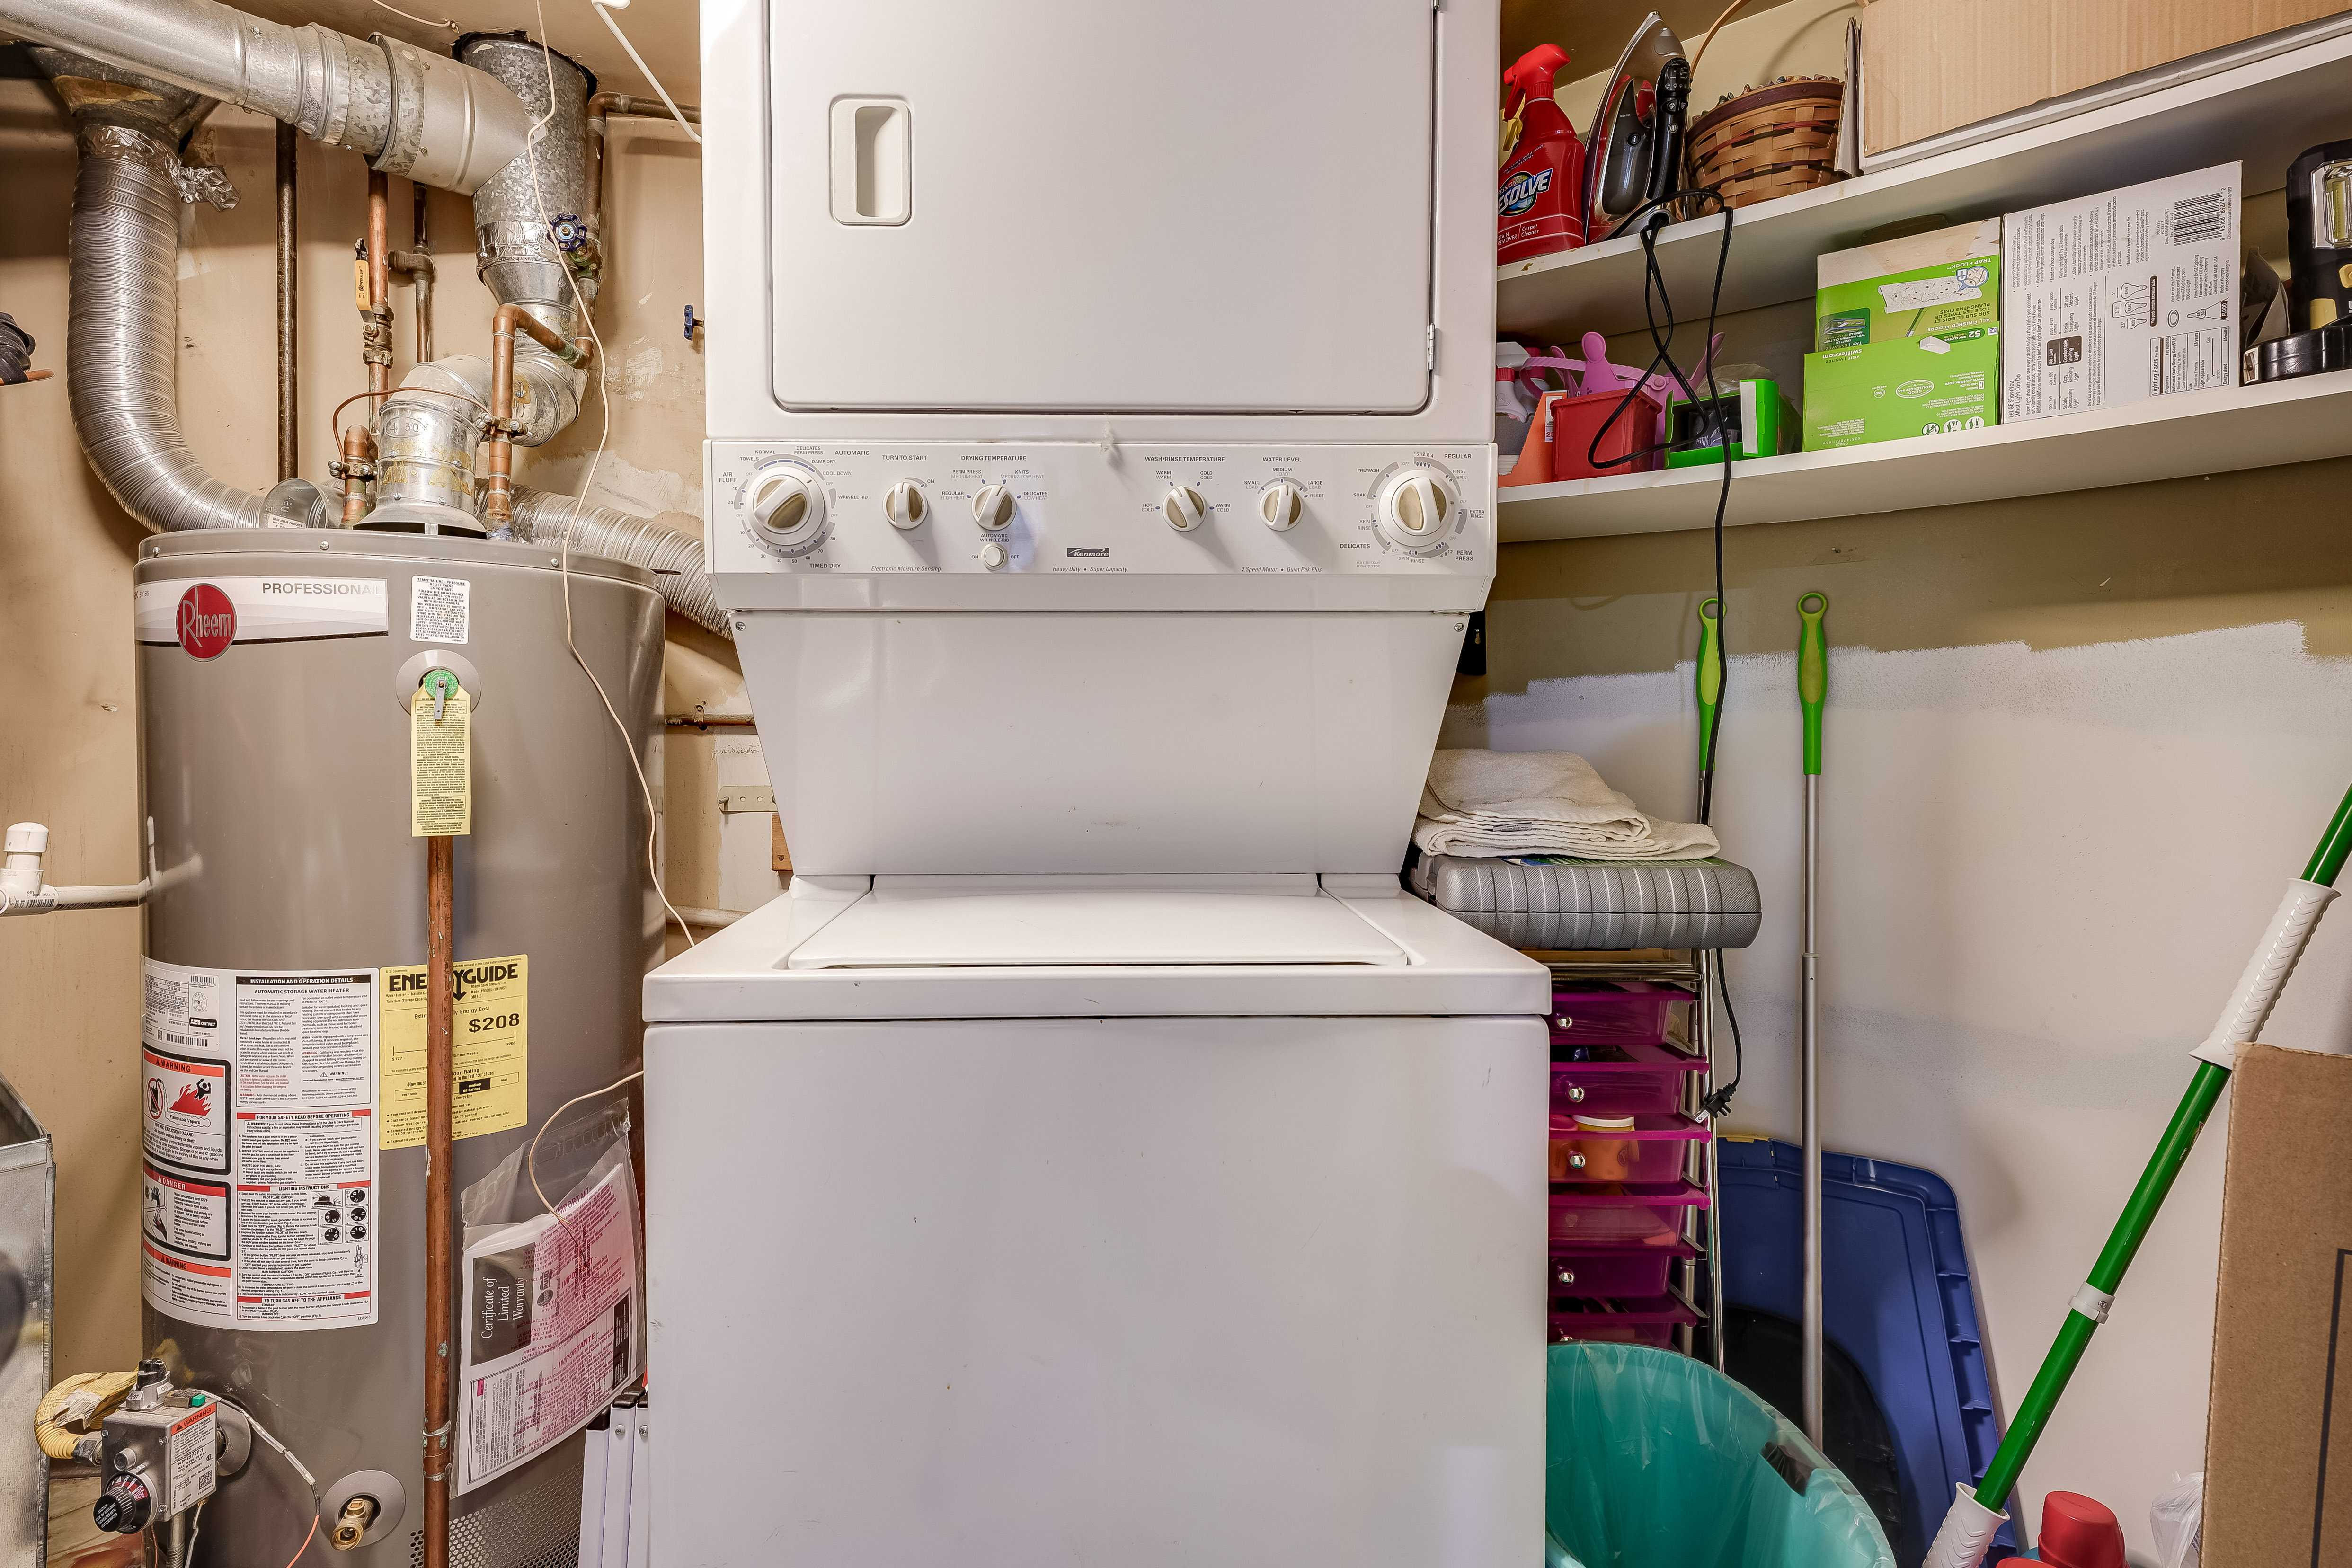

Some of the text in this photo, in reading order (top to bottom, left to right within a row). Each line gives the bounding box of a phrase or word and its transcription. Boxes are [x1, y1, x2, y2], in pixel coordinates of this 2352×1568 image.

[1499, 171, 1550, 213] ESOLVE
[1498, 232, 1509, 240] STAIN
[1498, 235, 1517, 245] REMOVER
[1951, 319, 1978, 328] FINISHED
[1968, 330, 1981, 338] 52
[1822, 348, 1862, 360] swiffer.com
[262, 583, 382, 597] PROFESSIONAL
[183, 587, 231, 647] Rheem
[469, 1013, 520, 1033] $208
[161, 1060, 191, 1072] WARNING
[163, 1178, 186, 1190] DANGER
[166, 1258, 187, 1269] WARNING
[498, 1286, 510, 1321] Limited
[513, 1277, 527, 1320] Warranty
[481, 1277, 497, 1339] Certificate of
[558, 1335, 595, 1369] IMPORTANTE
[184, 1408, 211, 1426] WARNING
